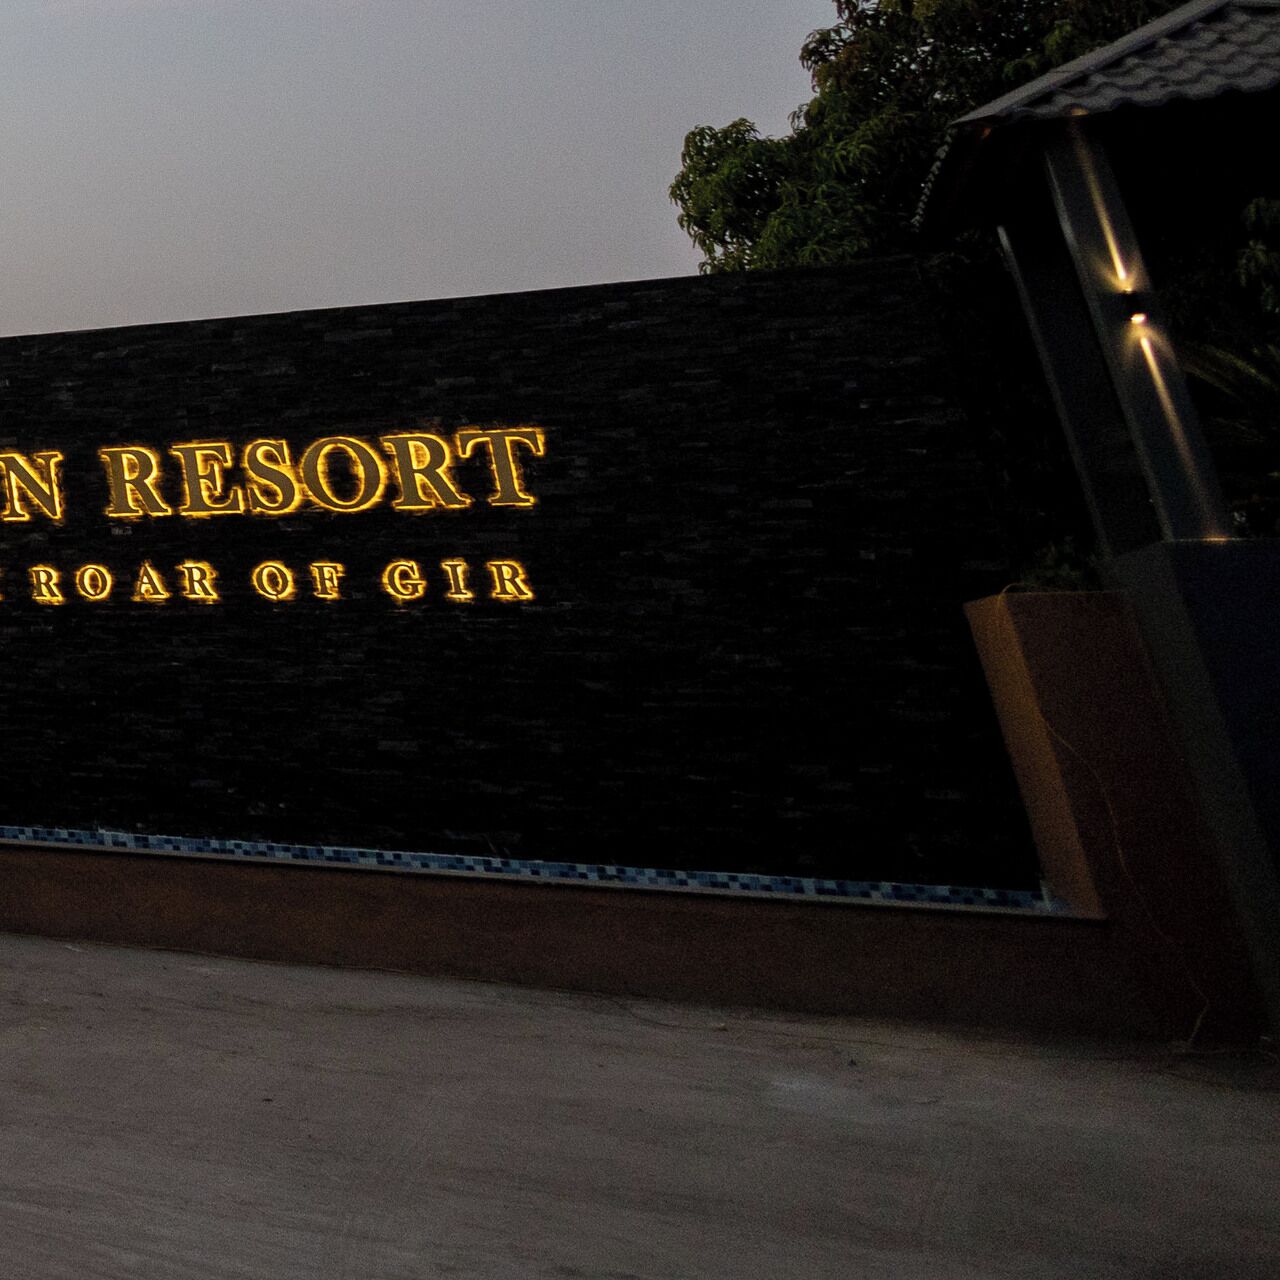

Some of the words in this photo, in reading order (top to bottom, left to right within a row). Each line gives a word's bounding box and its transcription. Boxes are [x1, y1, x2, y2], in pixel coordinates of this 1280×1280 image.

[99, 427, 545, 518] RESORT
[29, 560, 219, 604] ROAR
[252, 560, 345, 601] OF
[382, 558, 534, 602] GIR
